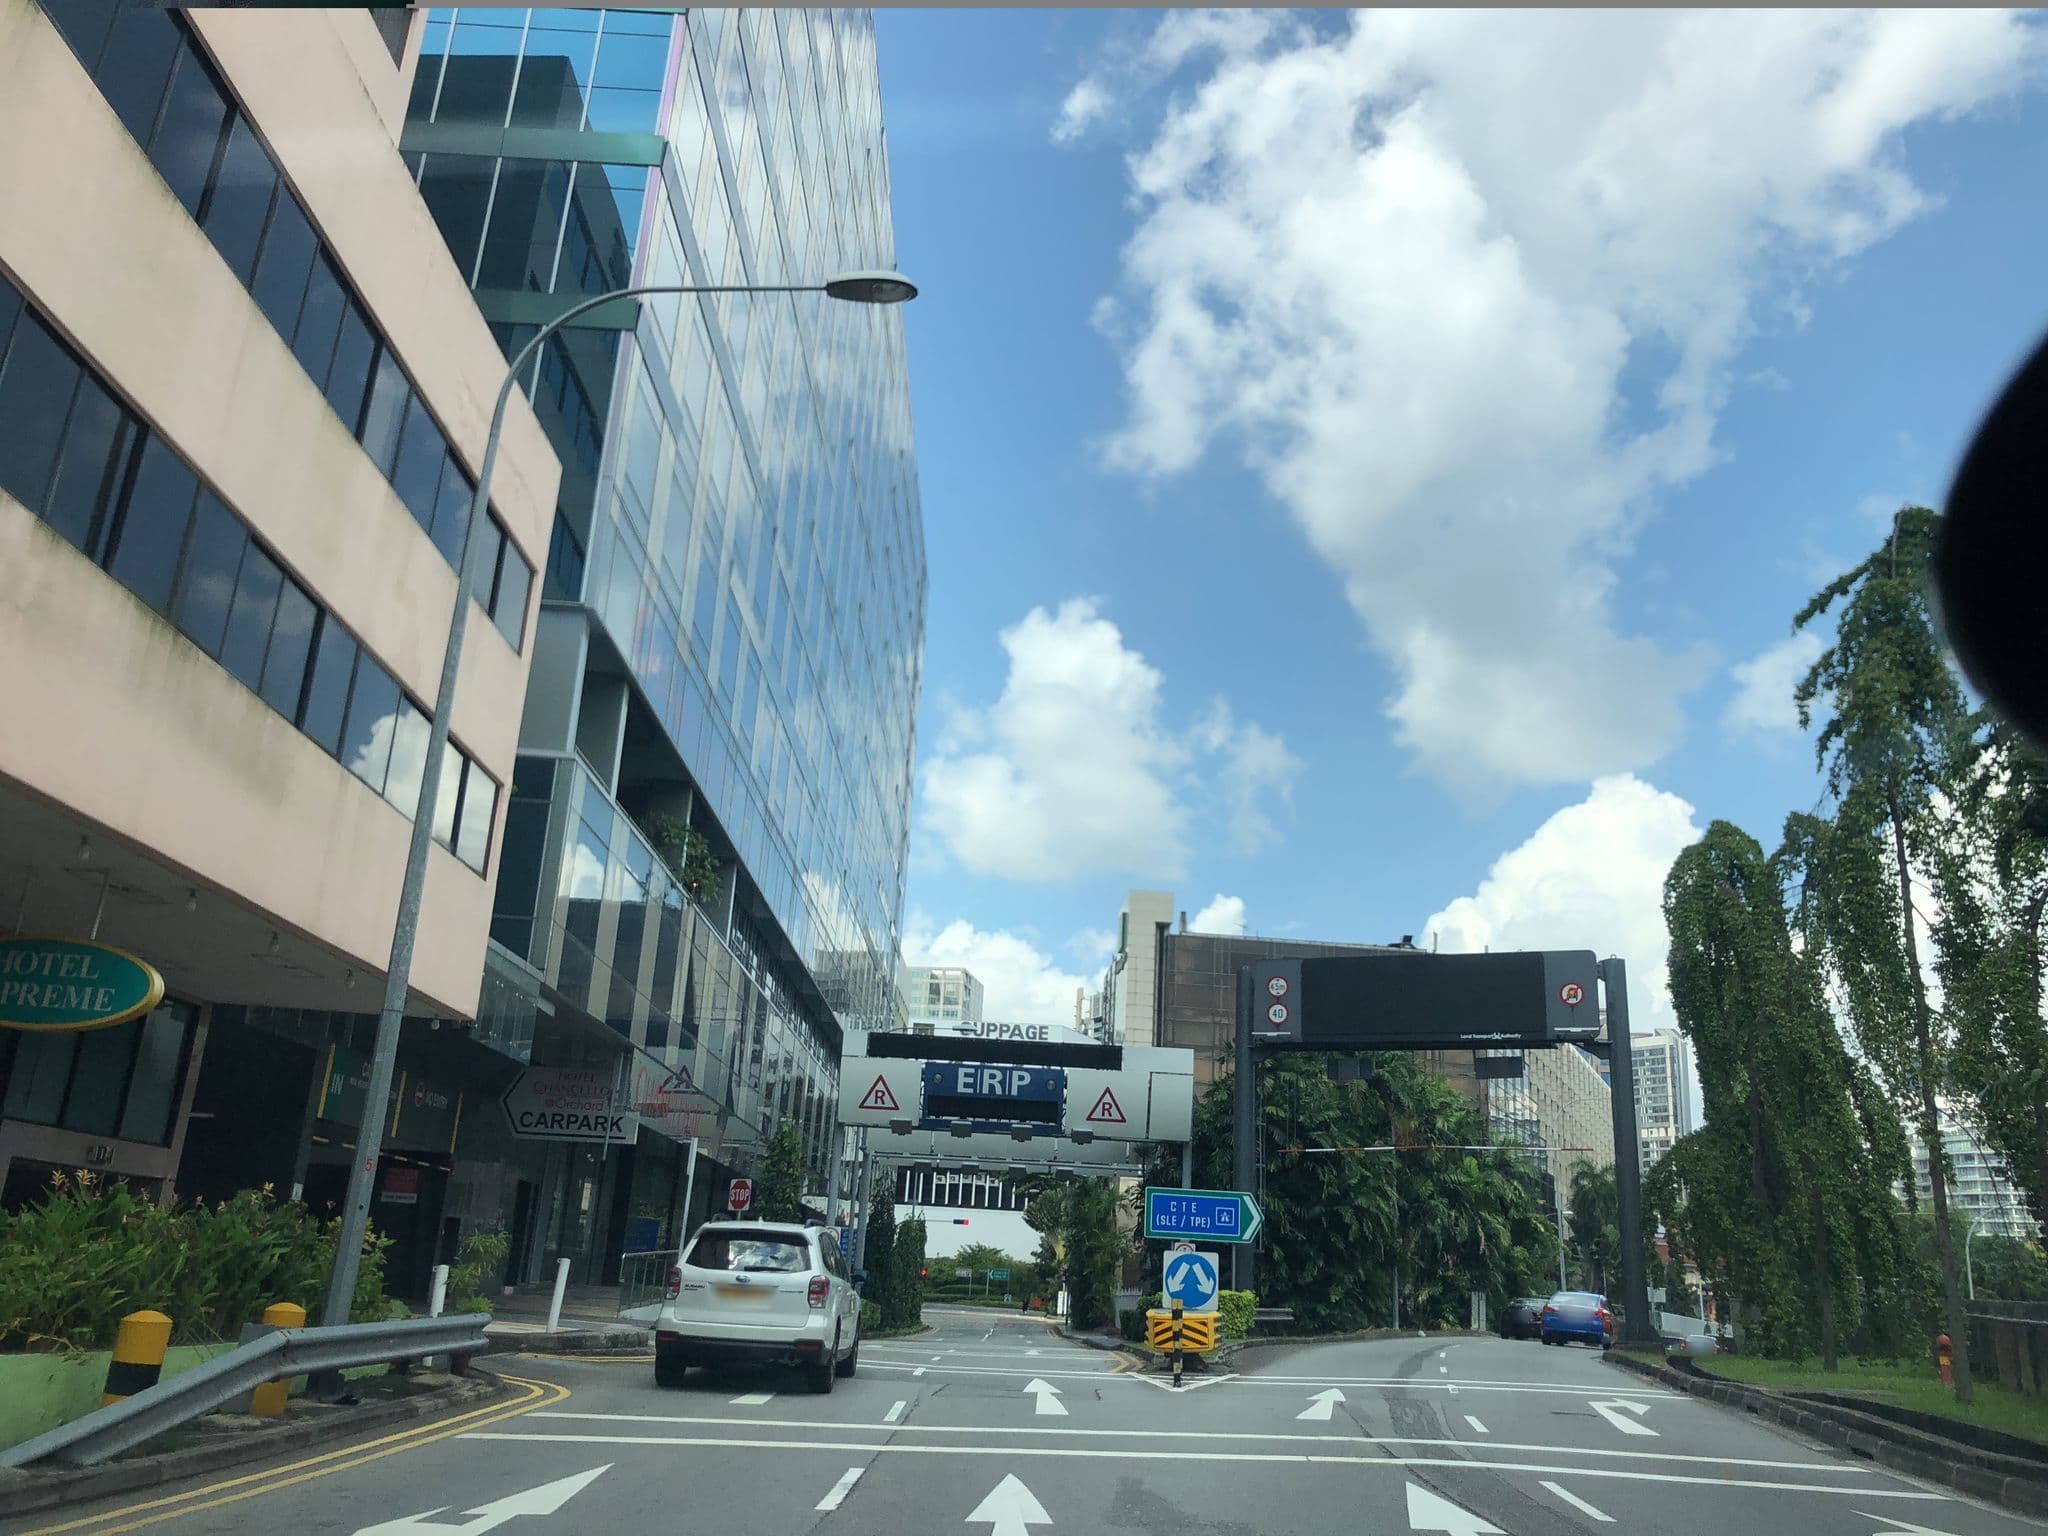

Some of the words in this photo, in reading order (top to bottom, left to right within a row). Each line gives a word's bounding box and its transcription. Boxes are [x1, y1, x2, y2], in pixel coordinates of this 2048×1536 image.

[1272, 1008, 1284, 1019] 40
[957, 1067, 1032, 1097] ERP
[874, 1089, 886, 1105] R
[1102, 1101, 1113, 1117] R
[520, 1111, 625, 1132] CARPARK
[730, 1188, 750, 1201] STOP
